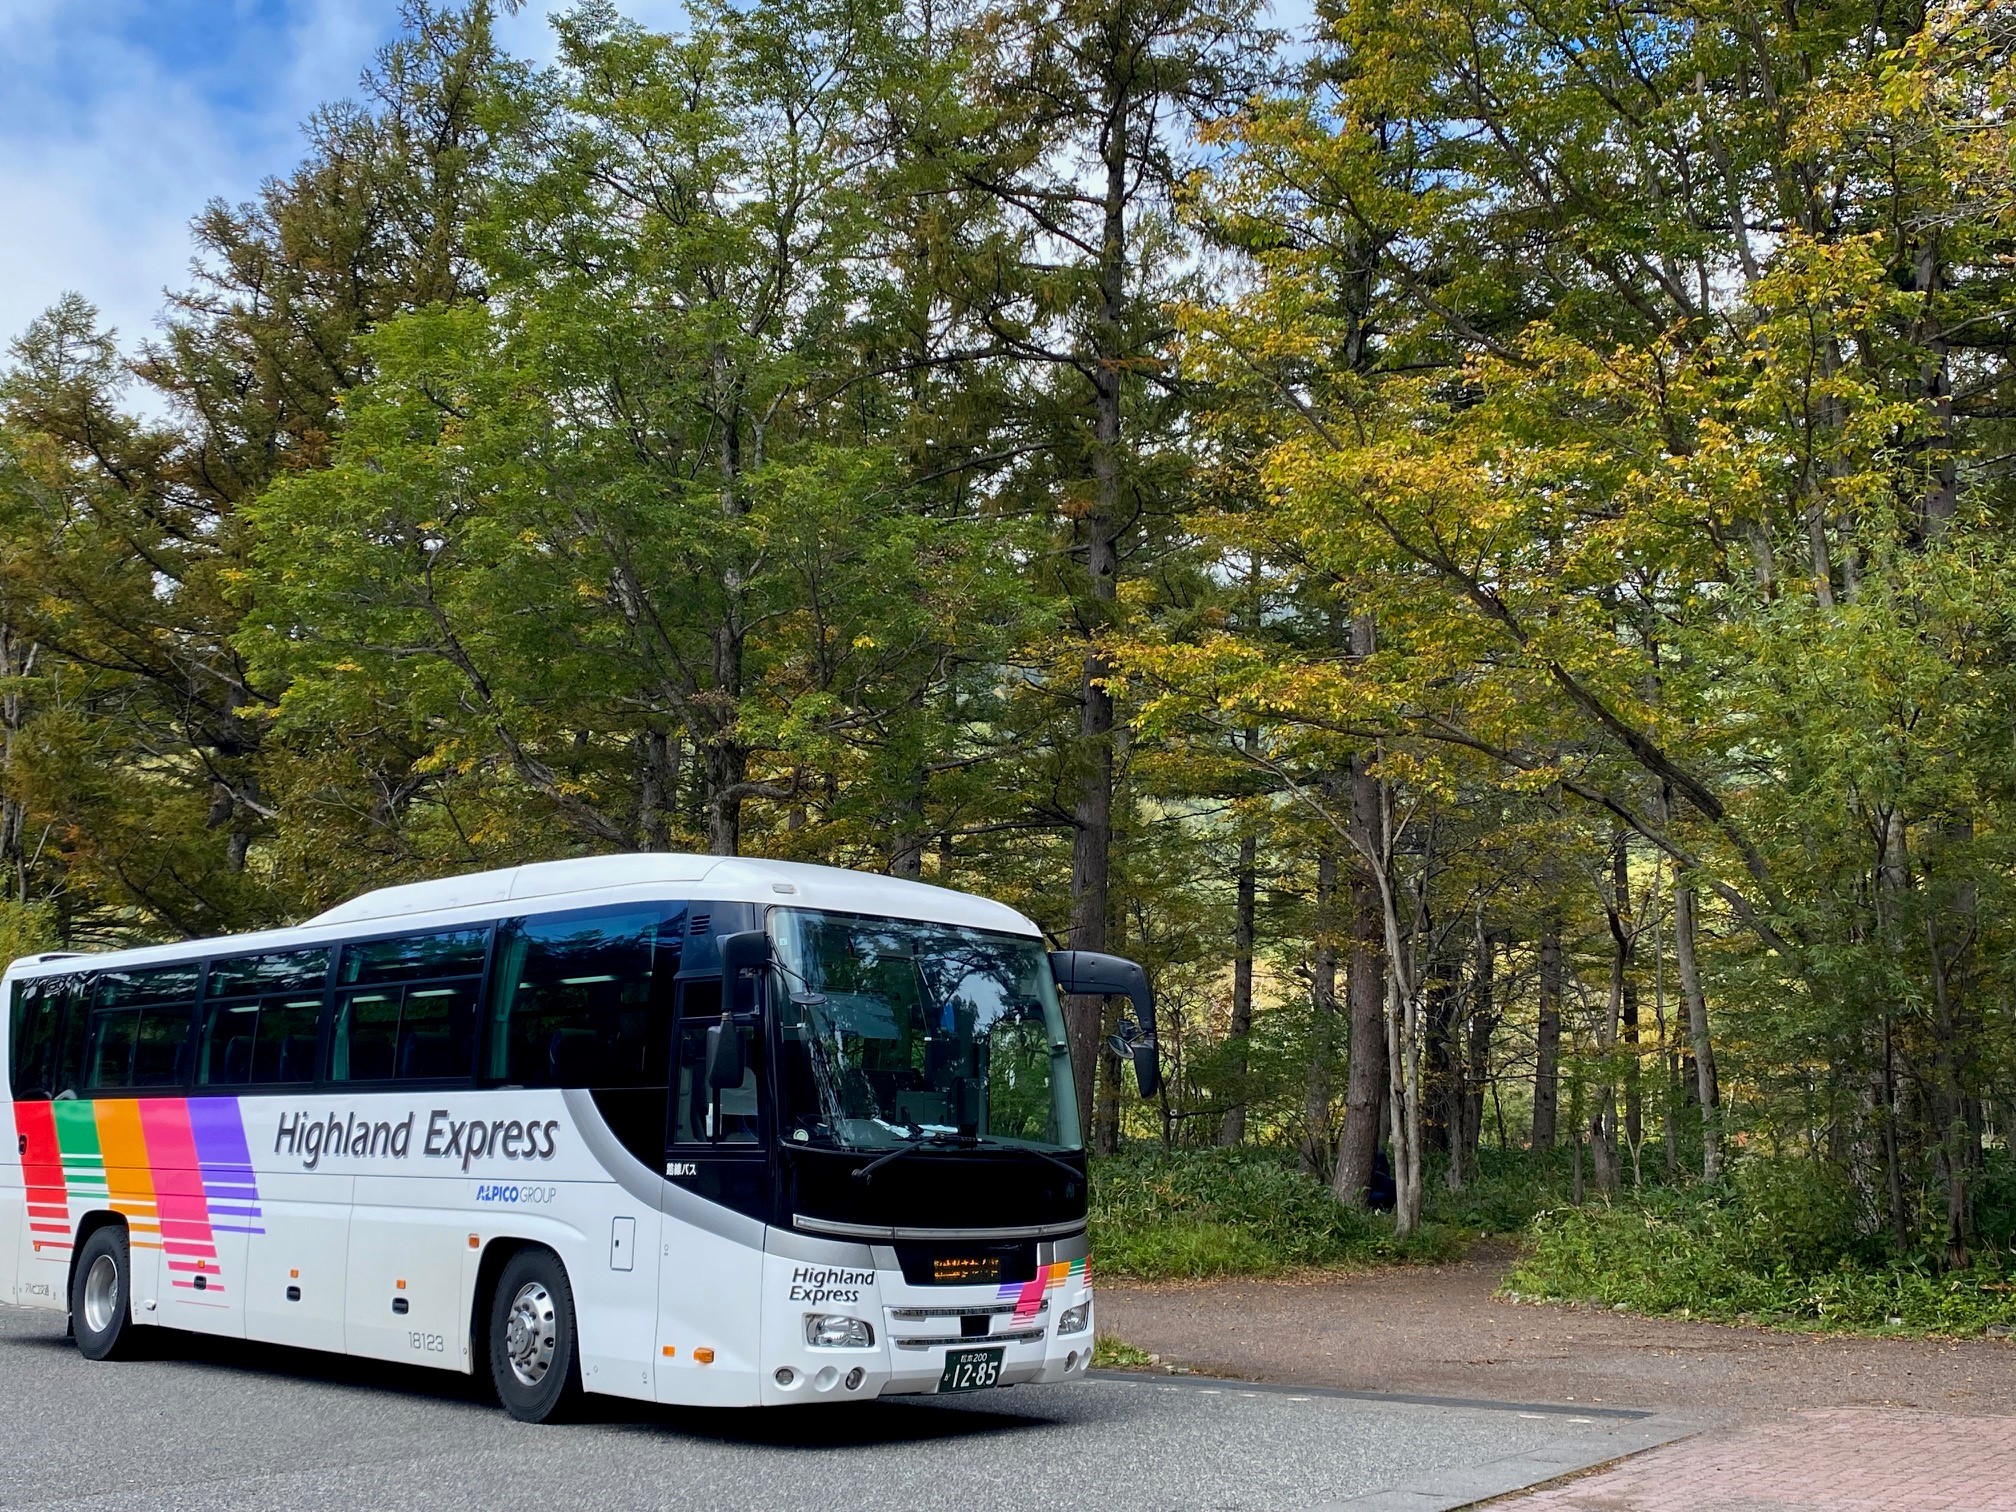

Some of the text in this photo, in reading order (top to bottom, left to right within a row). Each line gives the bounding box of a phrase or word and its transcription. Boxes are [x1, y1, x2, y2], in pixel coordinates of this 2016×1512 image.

[273, 1109, 560, 1174] Highland Express
[665, 1162, 697, 1176] 路線バス
[475, 1185, 557, 1204] ALPICO GROUP
[792, 1267, 875, 1288] Highland
[789, 1285, 859, 1306] Express
[408, 1331, 444, 1353] 18123
